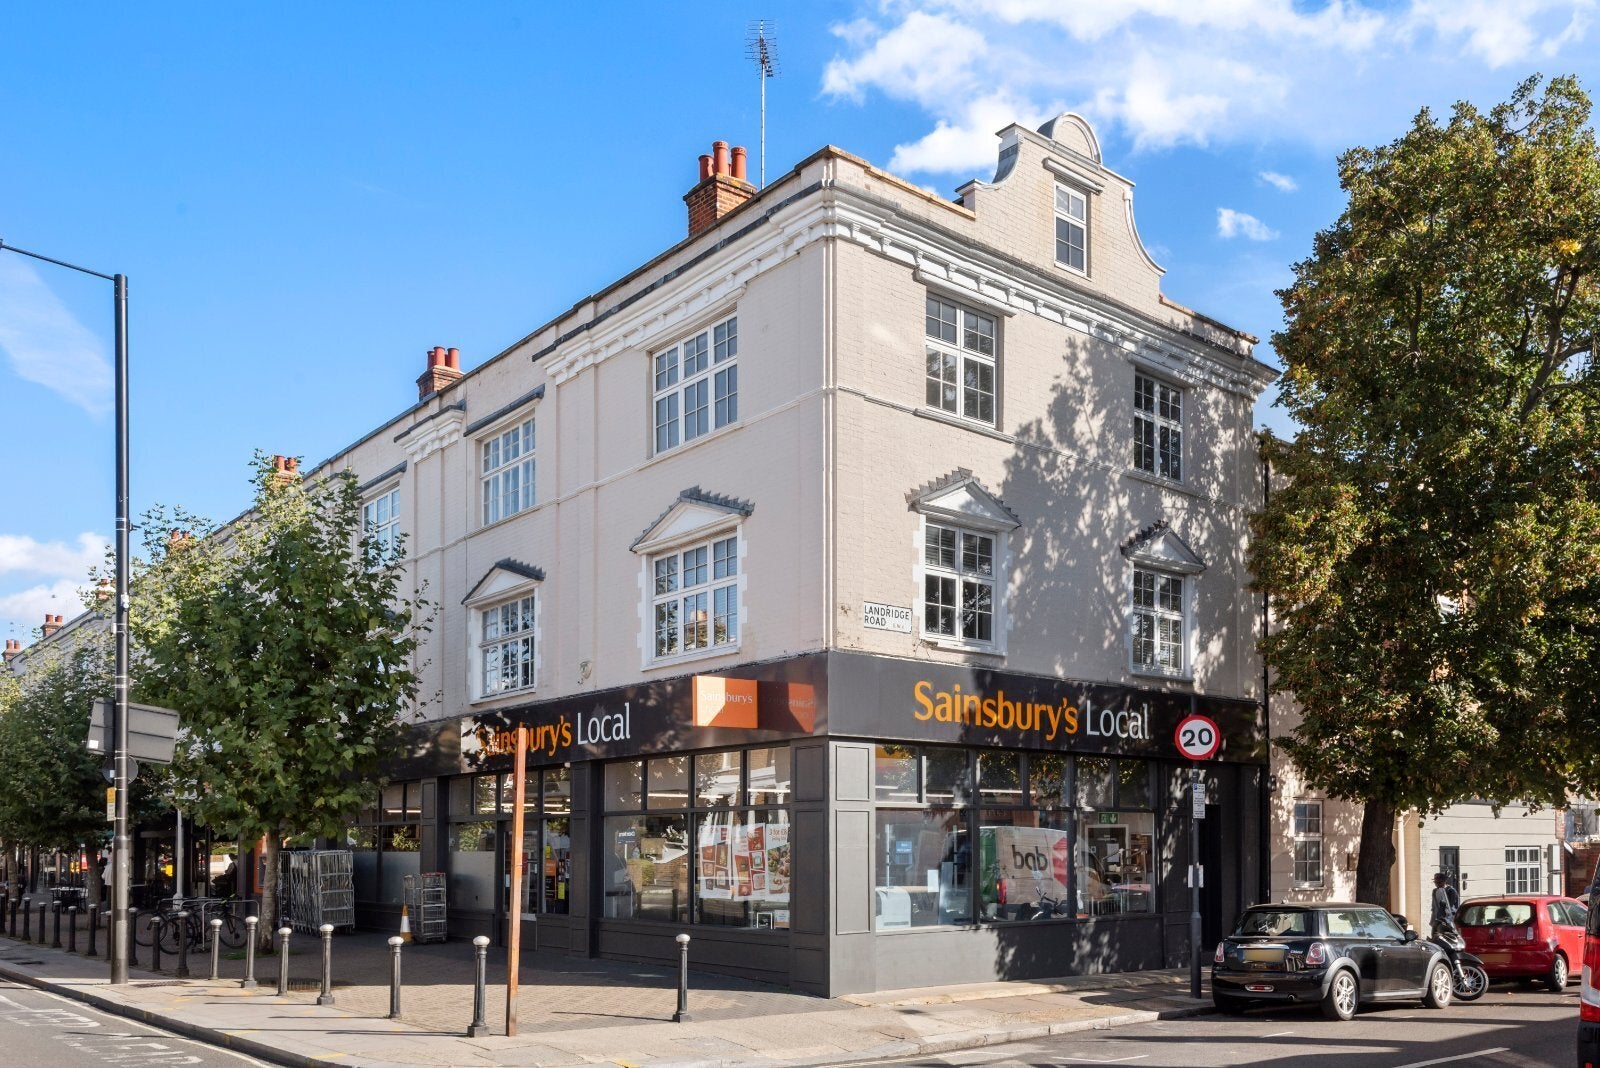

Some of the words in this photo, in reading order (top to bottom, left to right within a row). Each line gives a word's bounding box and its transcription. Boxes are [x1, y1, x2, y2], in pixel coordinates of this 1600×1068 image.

[864, 605, 910, 620] LANDRIDGE
[864, 615, 887, 626] ROAD
[914, 680, 1078, 741] Sainsbury's
[1086, 700, 1149, 740] Local
[577, 702, 631, 745] Local
[1182, 728, 1213, 748] 20
